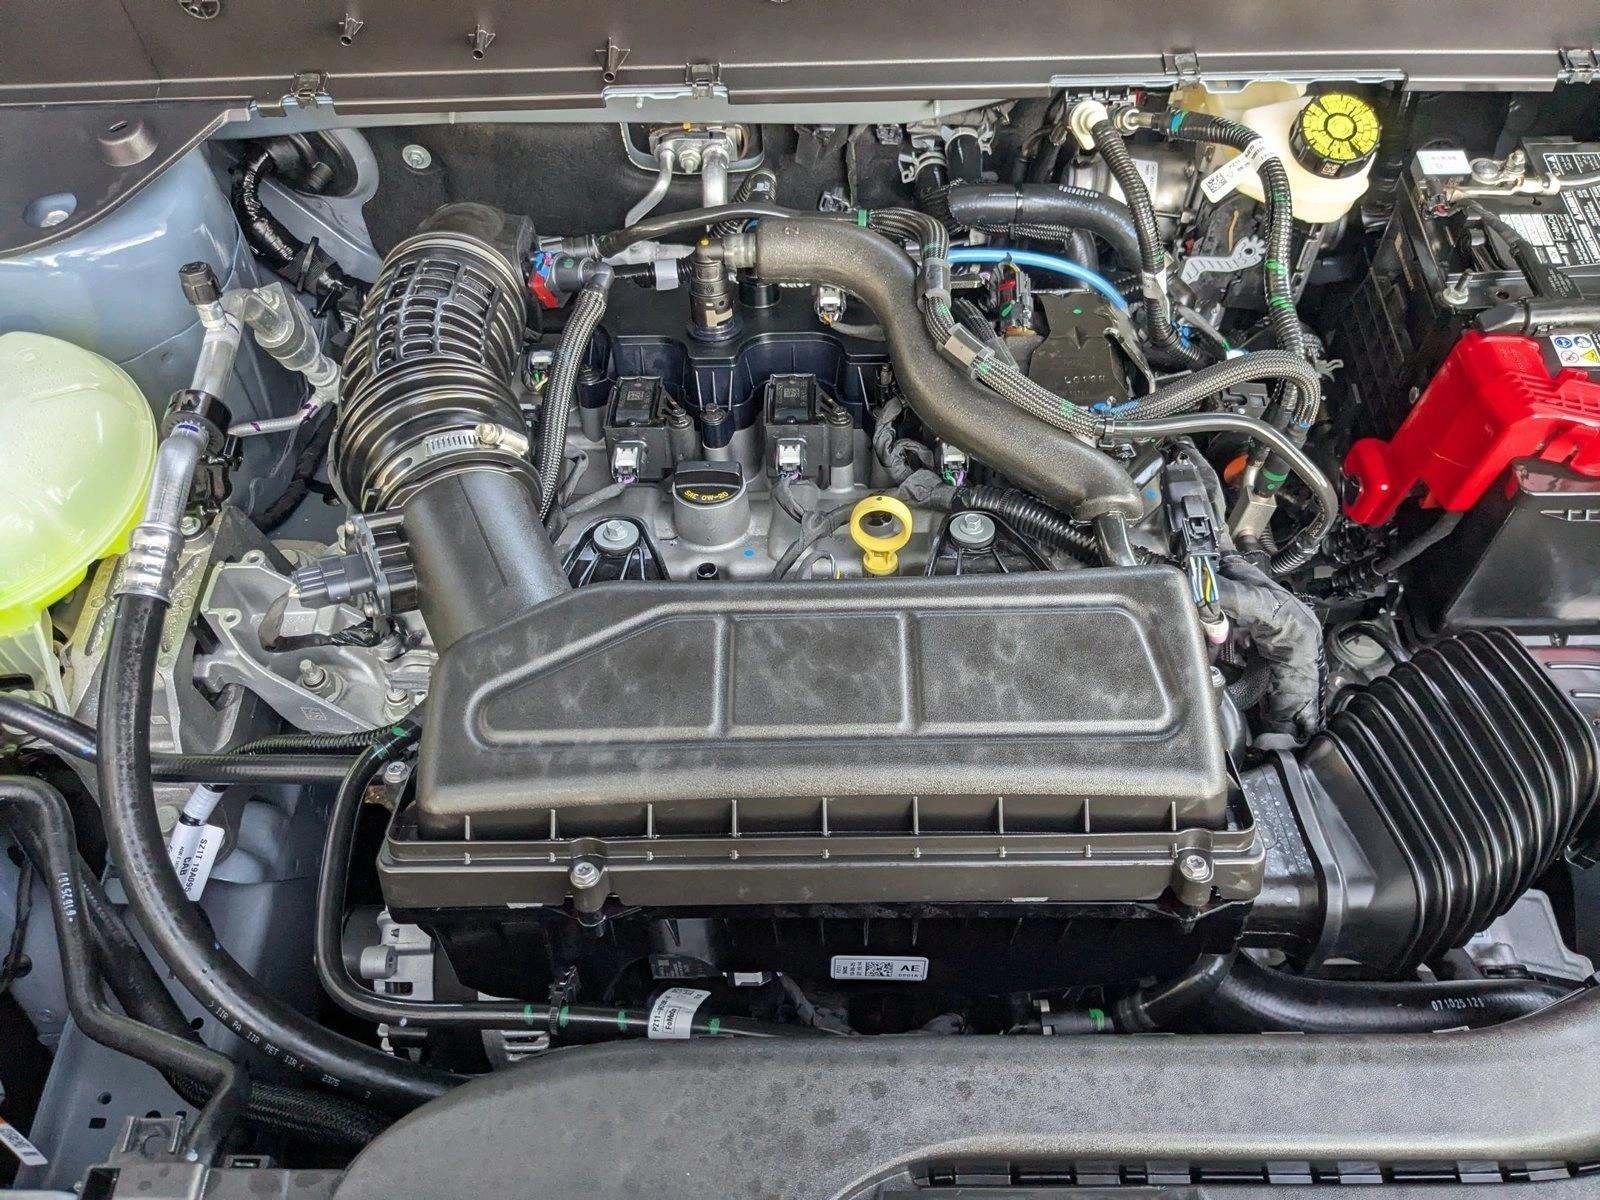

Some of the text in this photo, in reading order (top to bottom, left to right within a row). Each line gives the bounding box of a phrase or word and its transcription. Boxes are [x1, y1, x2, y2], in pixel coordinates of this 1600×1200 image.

[684, 489, 729, 501] SAE 0W-20
[179, 856, 192, 876] CAB
[665, 1008, 678, 1031] FoMoCo
[232, 1020, 242, 1031] PA
[264, 1043, 280, 1056] PET
